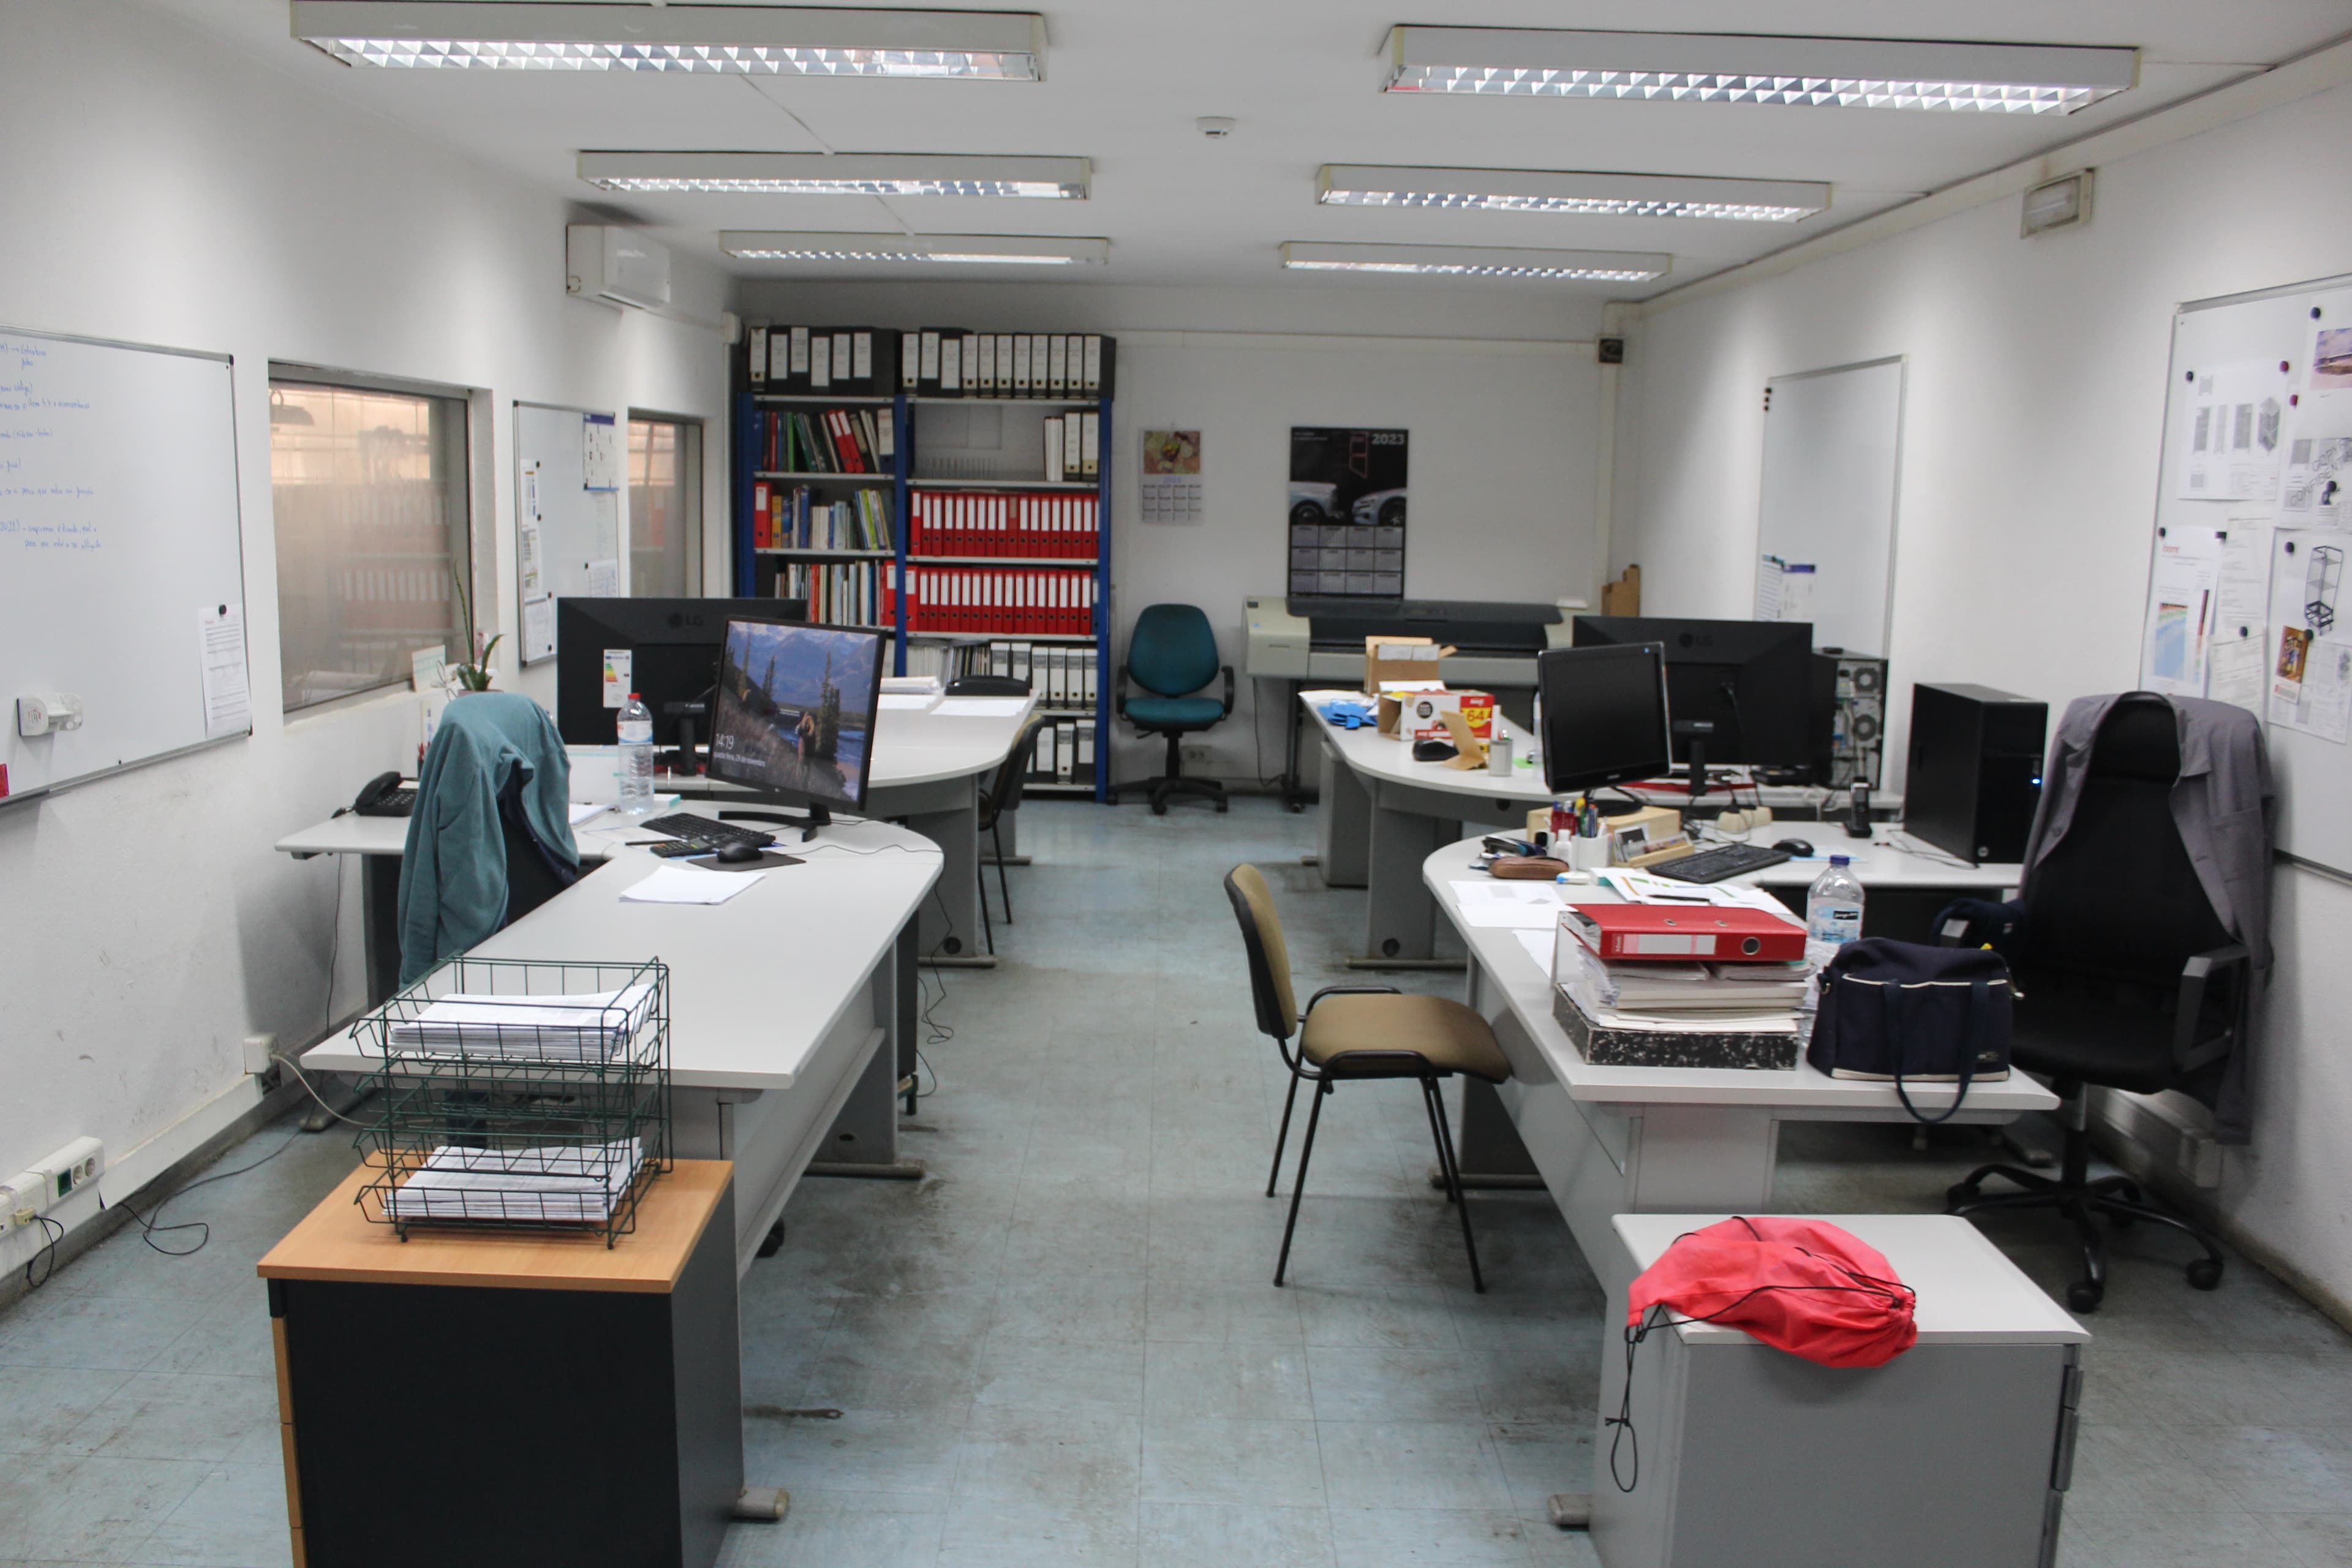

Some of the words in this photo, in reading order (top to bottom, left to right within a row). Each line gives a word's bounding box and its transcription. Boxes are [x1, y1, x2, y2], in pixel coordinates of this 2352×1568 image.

[1371, 432, 1404, 445] 2023
[1466, 710, 1484, 722] 64
[715, 733, 734, 750] 14:19
